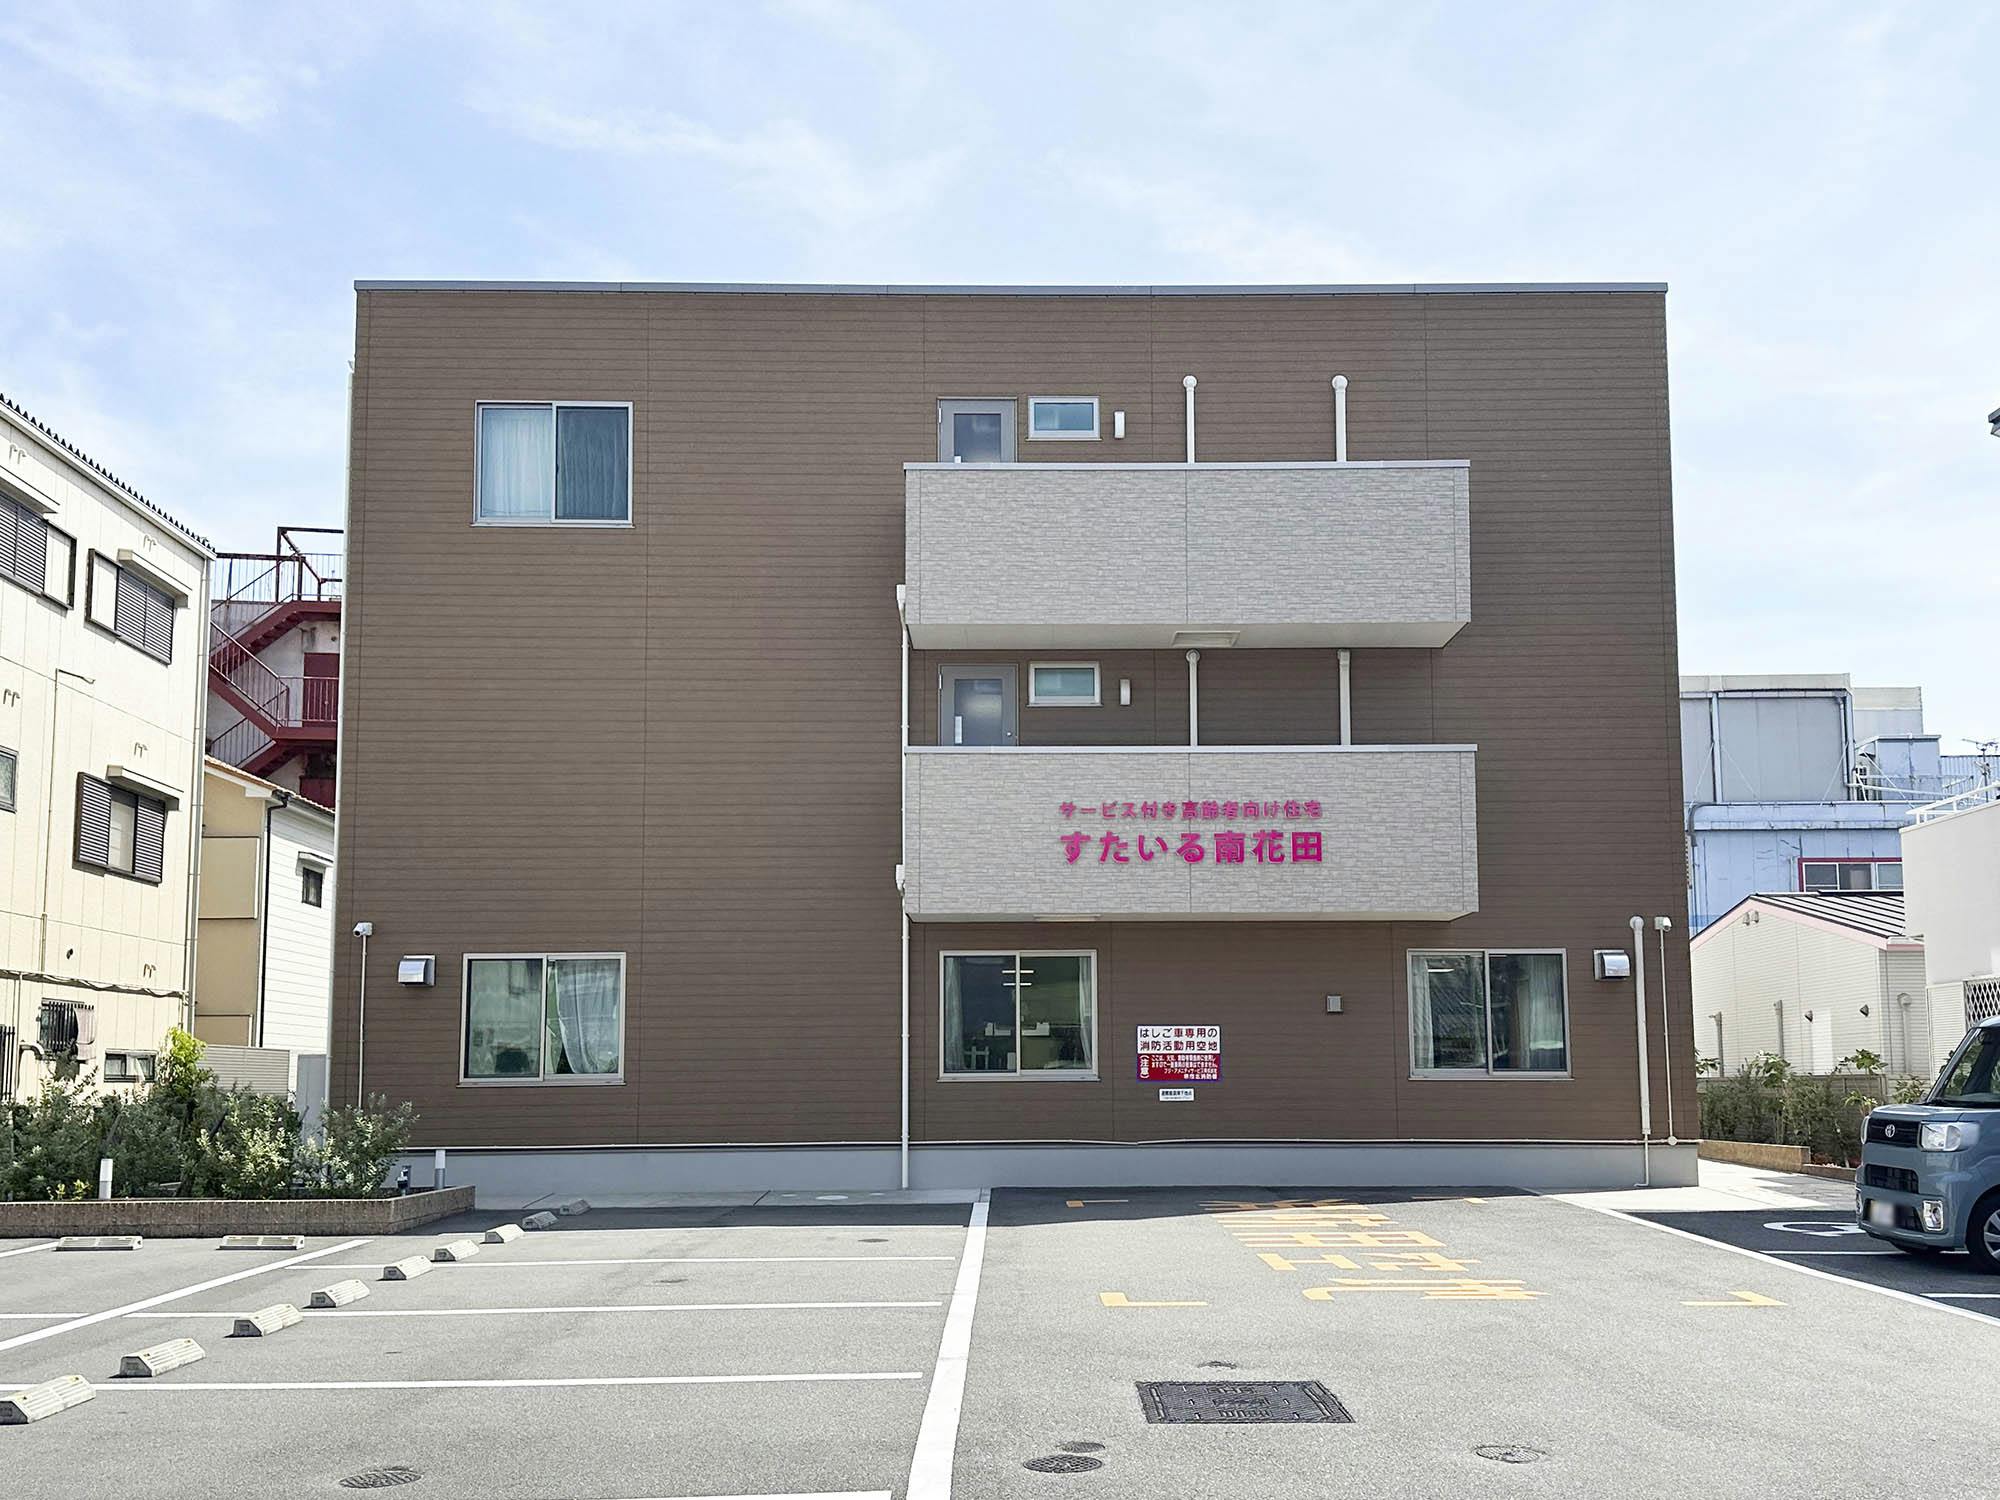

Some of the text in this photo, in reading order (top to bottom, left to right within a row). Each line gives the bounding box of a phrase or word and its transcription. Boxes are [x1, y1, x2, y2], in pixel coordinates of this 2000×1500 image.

[1060, 799, 1323, 820] サービス付き高齢者向け住宅
[1060, 830, 1323, 865] すたいる南花田
[1139, 1027, 1218, 1038] はしご車専用の
[1139, 1040, 1218, 1051] 消防活動用空地
